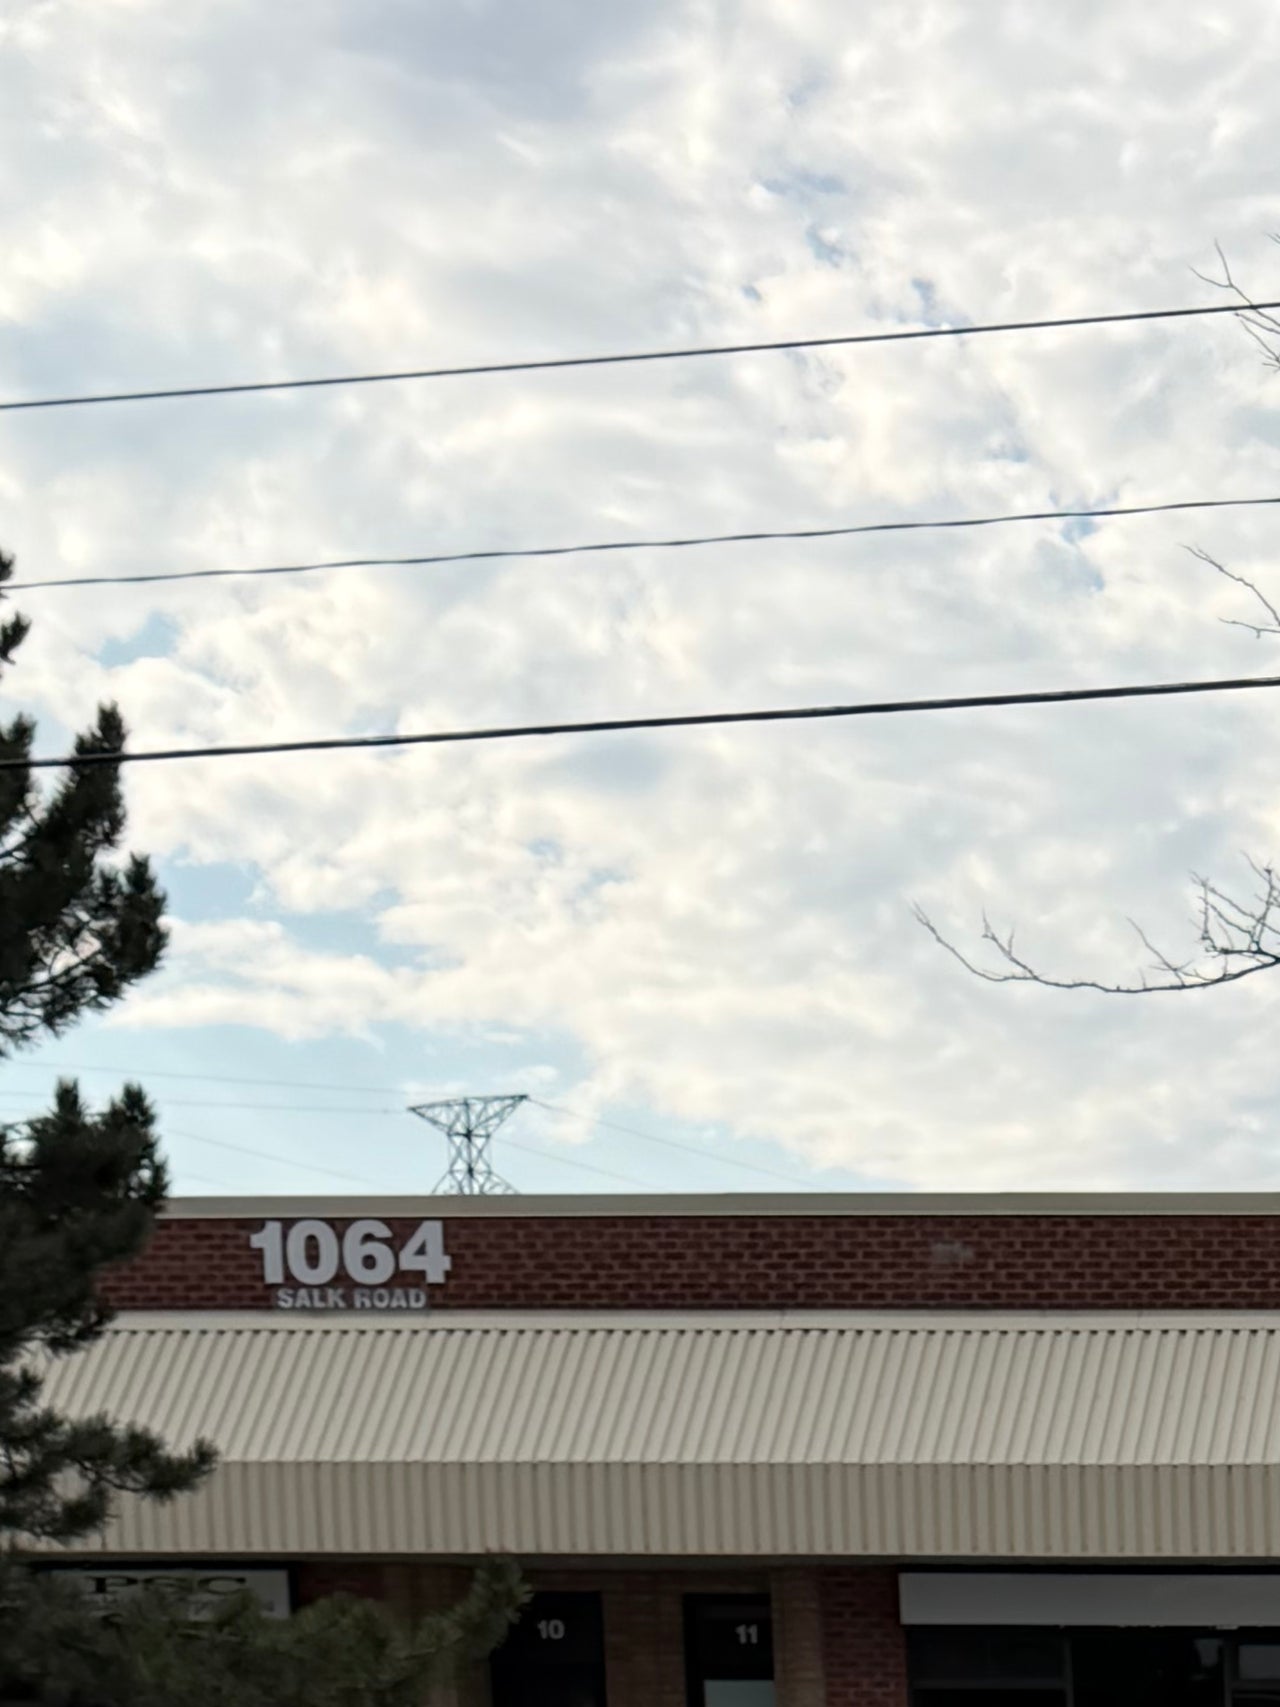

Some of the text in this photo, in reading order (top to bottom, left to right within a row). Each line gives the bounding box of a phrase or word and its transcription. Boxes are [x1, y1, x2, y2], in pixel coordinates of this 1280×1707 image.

[250, 1219, 452, 1285] 1064
[277, 1288, 427, 1309] SALK ROAD
[537, 1619, 565, 1640] 10
[735, 1624, 759, 1645] 11
